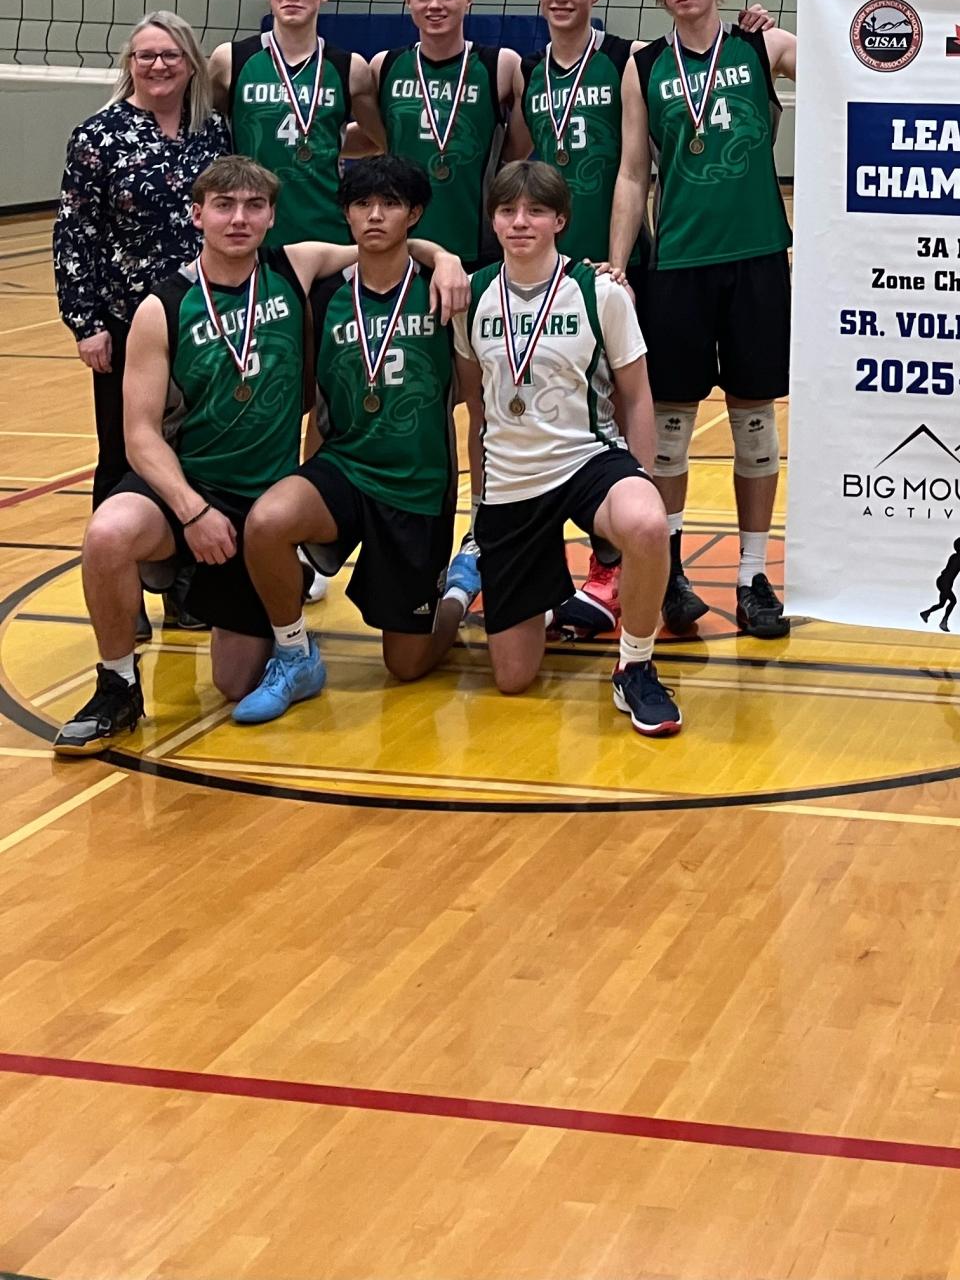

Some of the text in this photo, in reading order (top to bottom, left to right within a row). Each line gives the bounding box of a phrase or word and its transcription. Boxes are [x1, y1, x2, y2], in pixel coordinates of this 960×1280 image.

[864, 36, 908, 48] CISAA
[277, 113, 299, 146] 4
[917, 237, 949, 259] 3A
[871, 268, 926, 290] Zone
[839, 309, 886, 337] SR.
[843, 474, 895, 499] BIG
